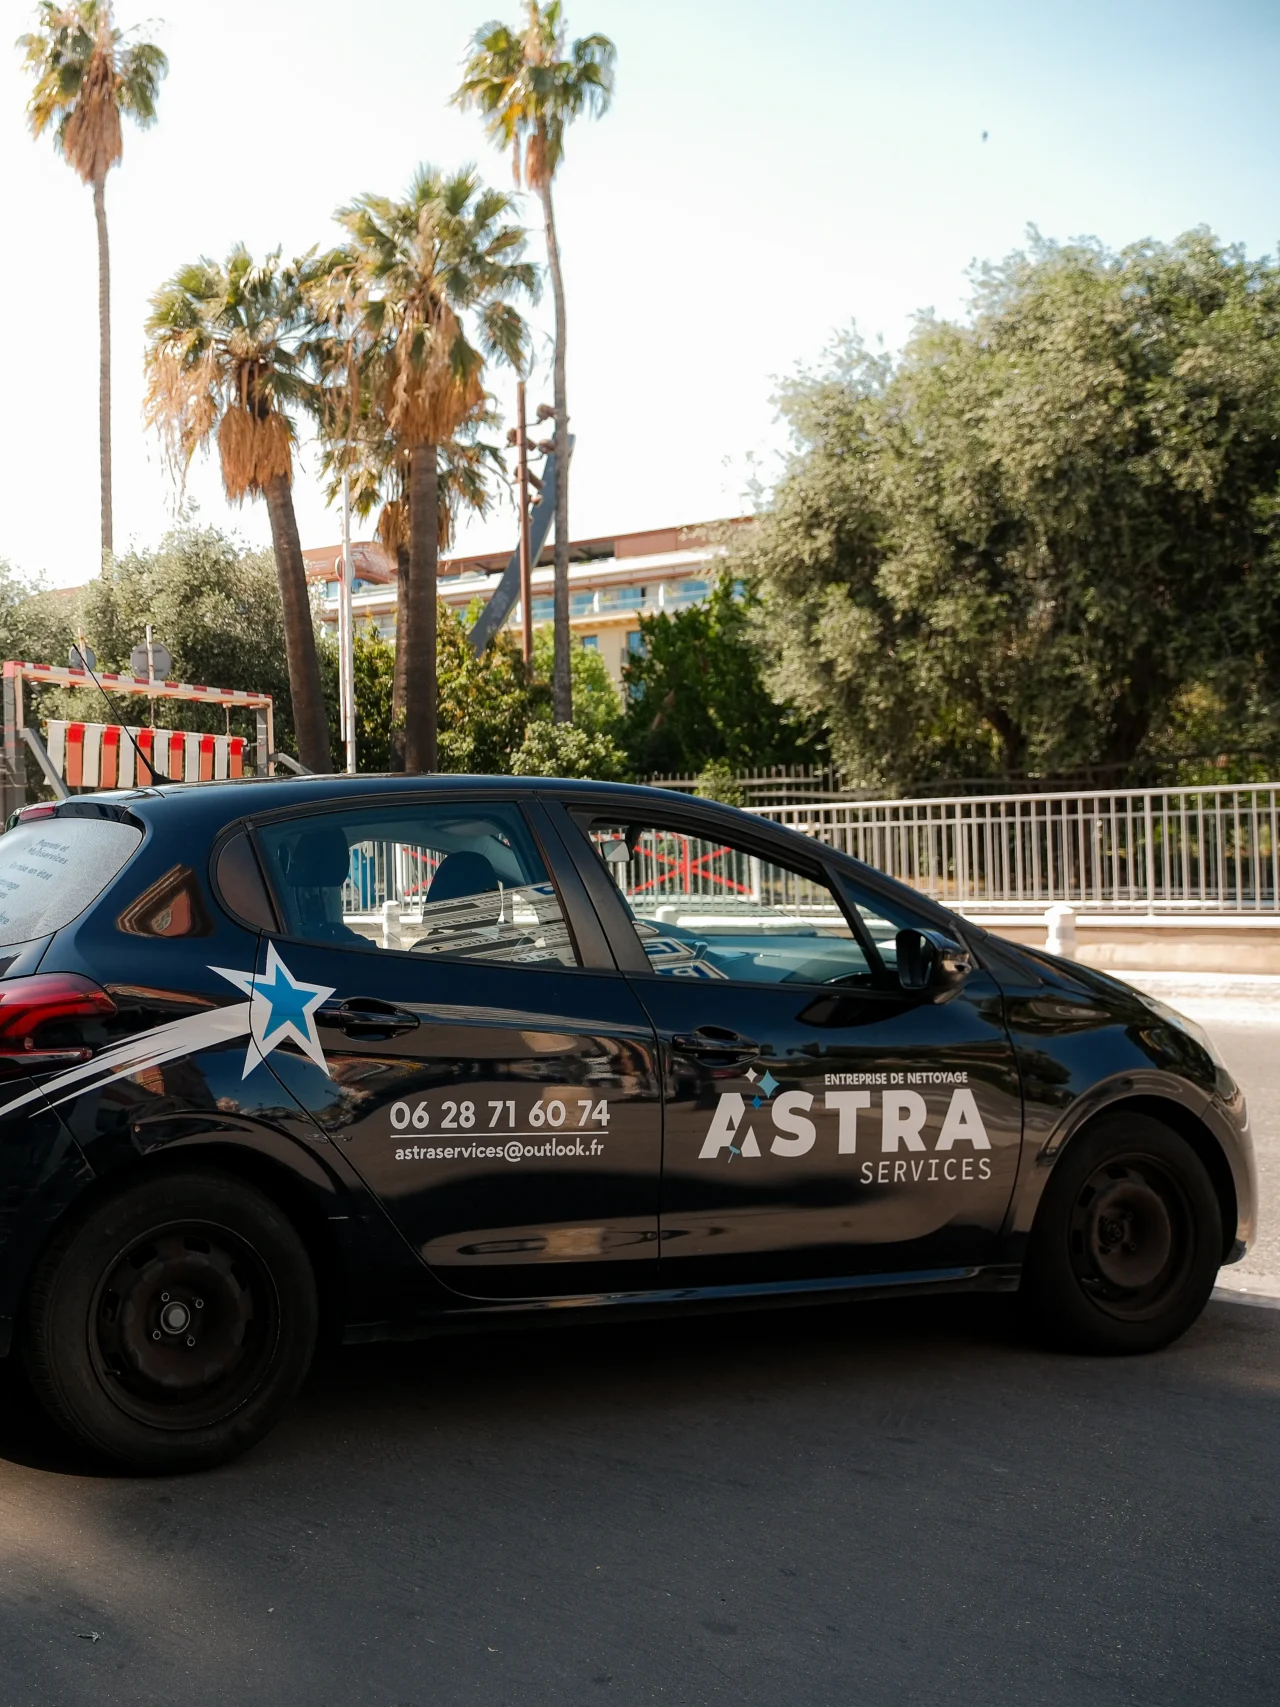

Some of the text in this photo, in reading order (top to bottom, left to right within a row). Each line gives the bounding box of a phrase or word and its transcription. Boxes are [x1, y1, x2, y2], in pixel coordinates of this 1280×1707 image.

[824, 1071, 969, 1086] ENTREPRISE DE NETTOYAGE
[390, 1098, 611, 1130] 06 28 71 60 74
[698, 1089, 992, 1159] ASTRA
[395, 1138, 605, 1162] astraservices@outlook.fr
[860, 1157, 993, 1184] SERVICES
